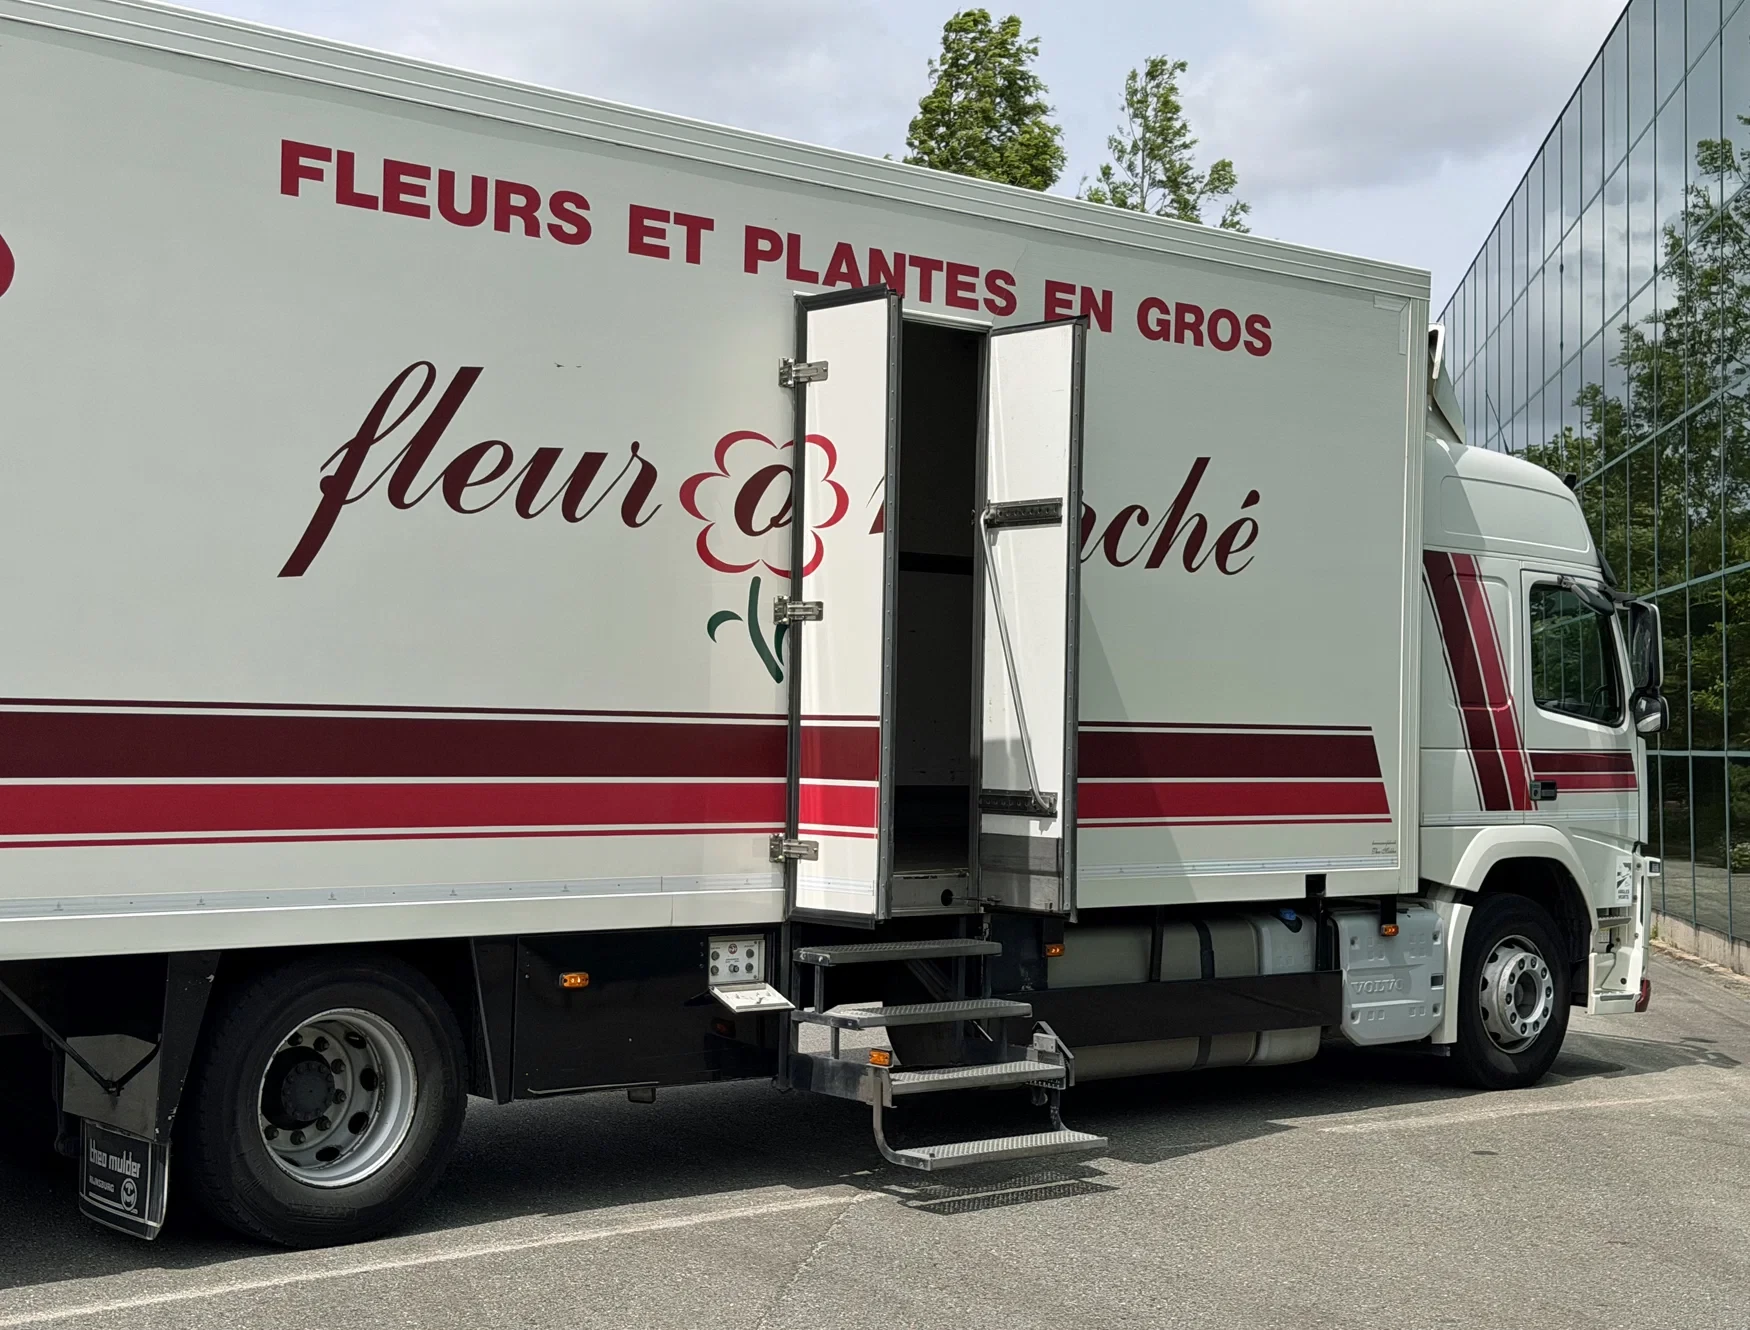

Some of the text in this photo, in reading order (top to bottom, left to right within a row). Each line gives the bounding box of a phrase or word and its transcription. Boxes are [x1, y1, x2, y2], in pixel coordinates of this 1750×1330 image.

[280, 138, 1273, 357] FLEURS ET PLANTES EN GROS
[277, 360, 662, 578] fleur
[1350, 979, 1405, 994] VOLVO
[89, 1137, 141, 1178] theo mulder
